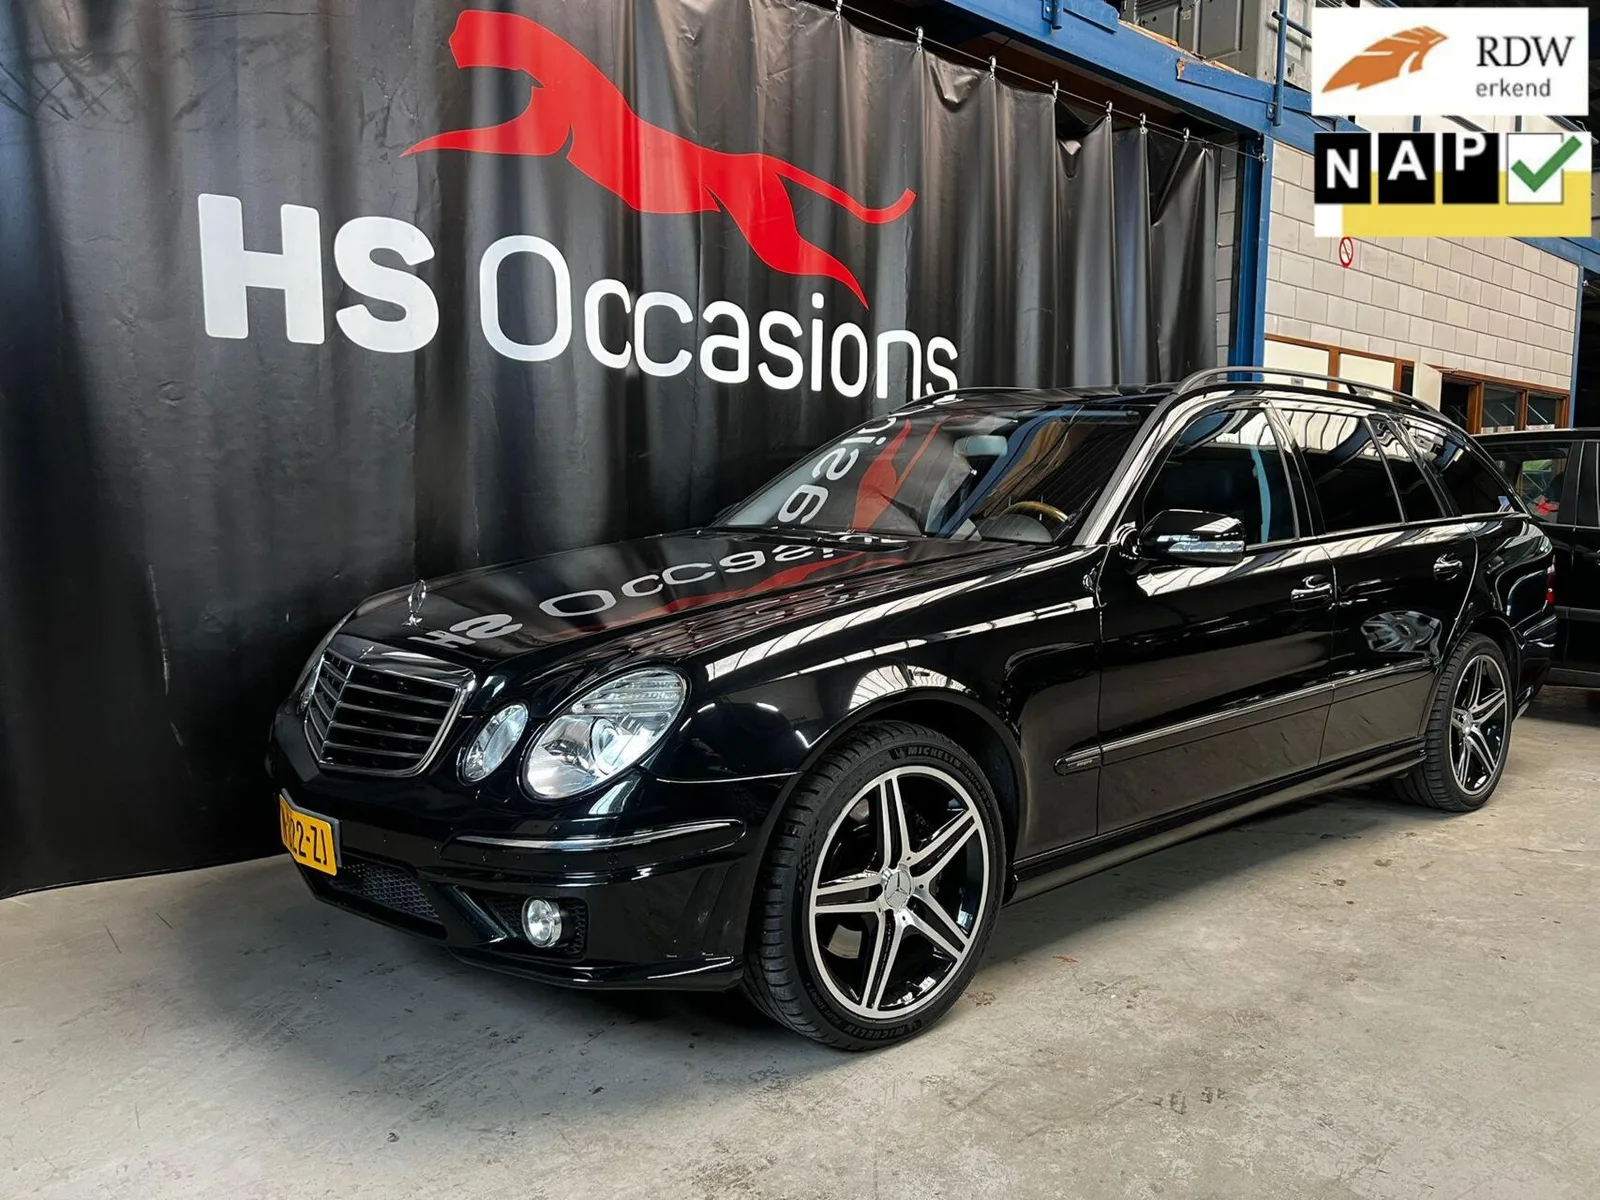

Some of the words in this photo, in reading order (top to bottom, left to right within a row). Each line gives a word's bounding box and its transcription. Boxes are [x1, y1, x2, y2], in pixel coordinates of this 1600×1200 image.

[198, 193, 439, 353] HS
[479, 235, 958, 400] Occasions
[907, 746, 961, 768] MICHELIN
